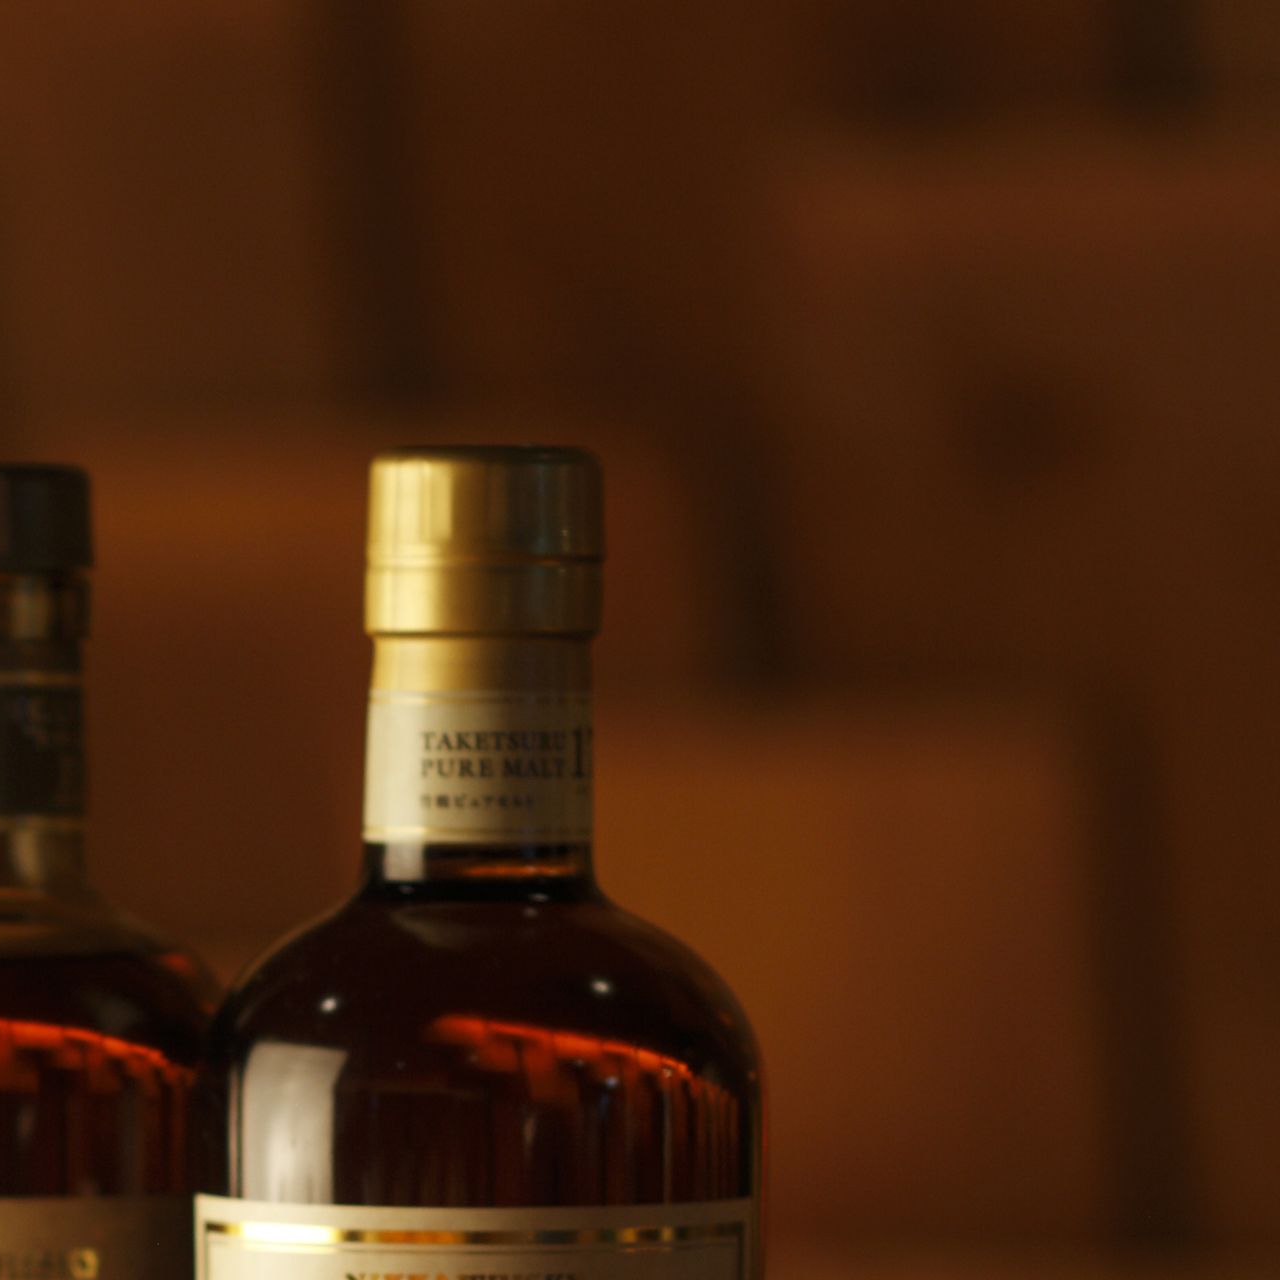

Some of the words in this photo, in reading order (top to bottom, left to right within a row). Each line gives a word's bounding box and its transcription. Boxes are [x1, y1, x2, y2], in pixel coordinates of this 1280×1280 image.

[420, 730, 567, 752] TAKETSURU
[571, 725, 593, 779] 1
[420, 757, 493, 778] PURE
[502, 757, 567, 779] MALT
